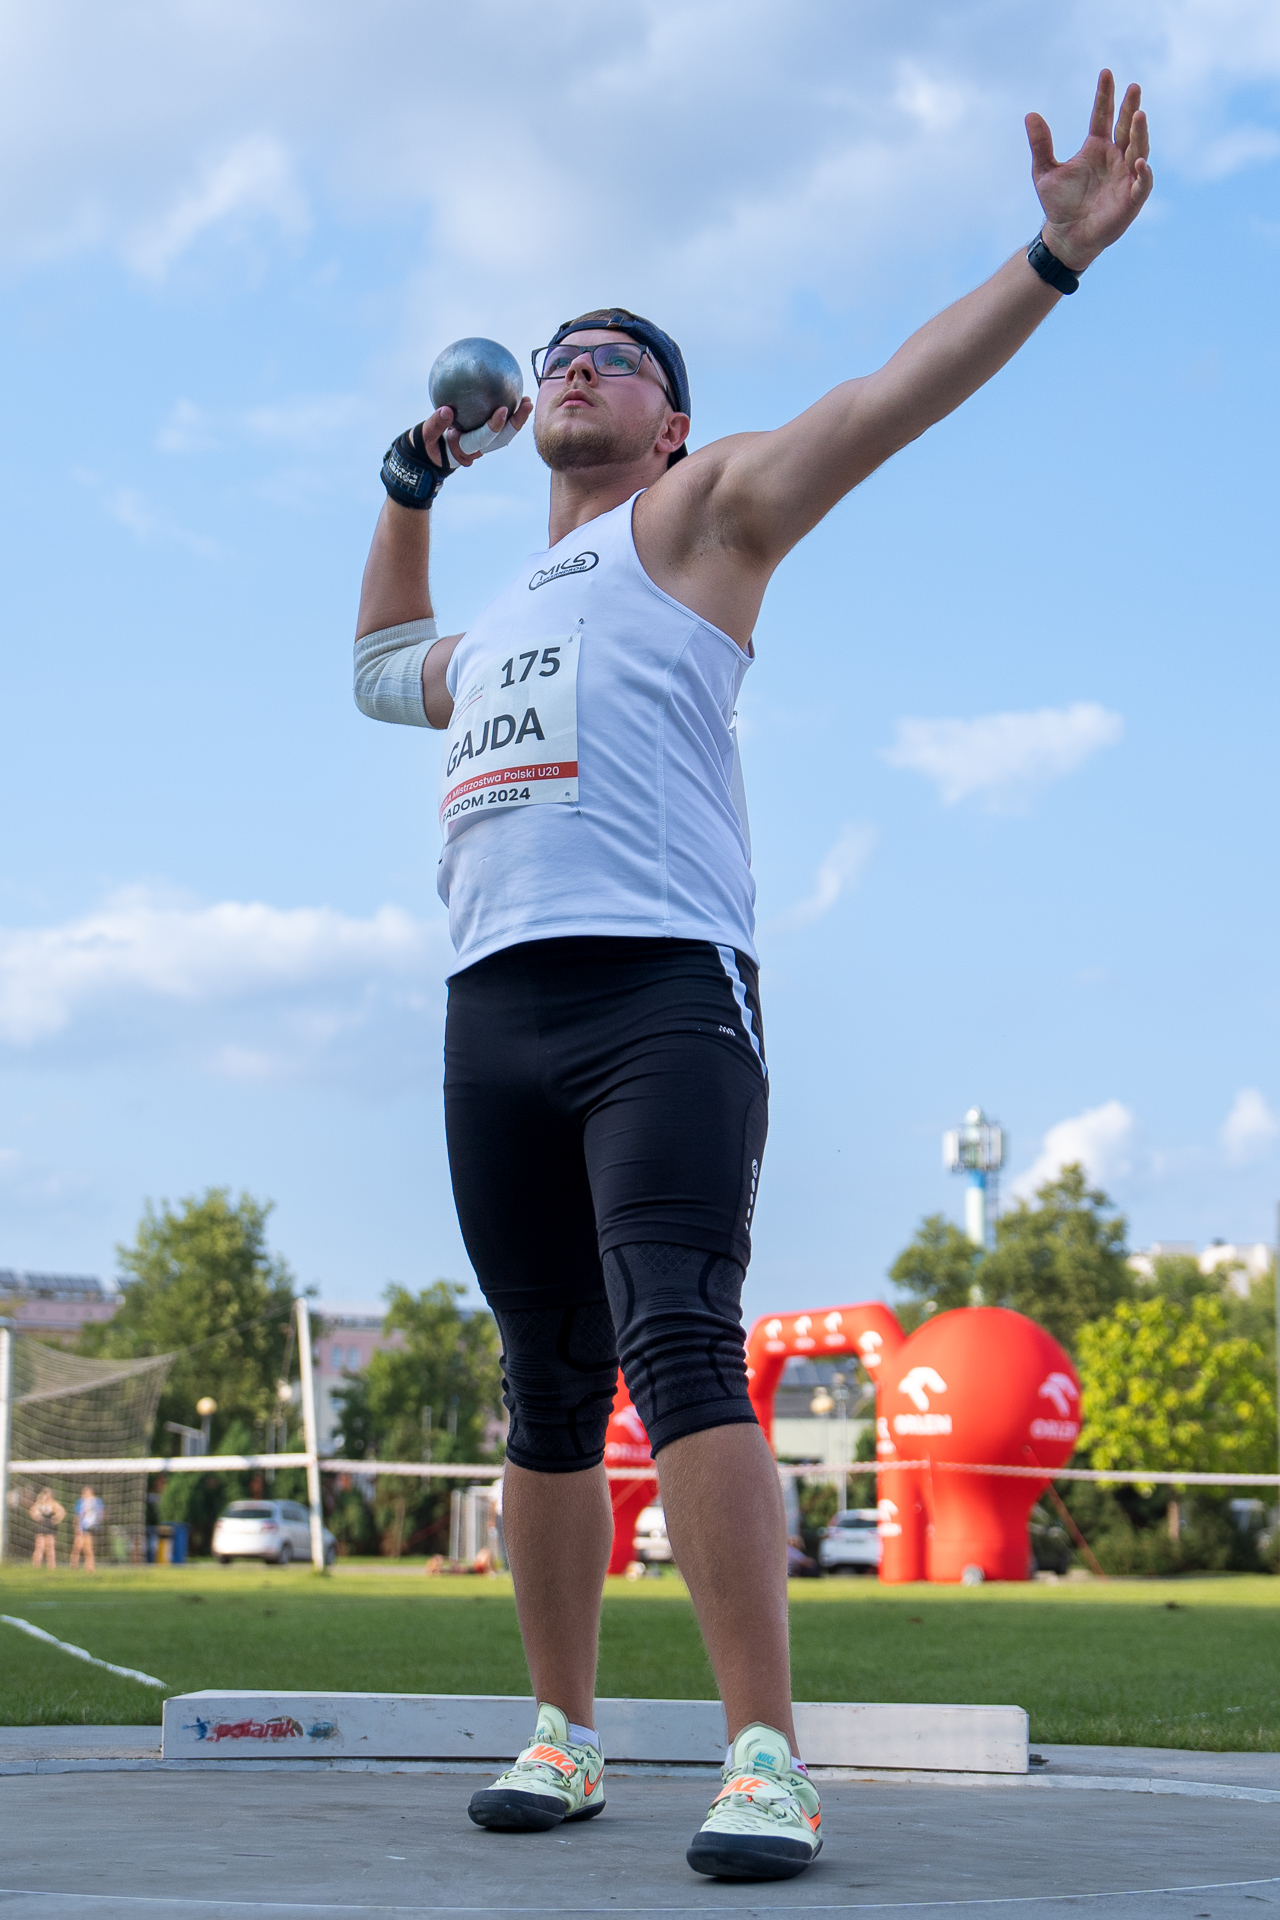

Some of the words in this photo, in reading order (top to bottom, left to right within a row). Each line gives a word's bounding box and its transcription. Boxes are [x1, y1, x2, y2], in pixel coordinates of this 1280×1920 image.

[501, 646, 561, 689] 175
[447, 707, 546, 778] GAJDA
[452, 774, 502, 798] Mistrzostwa
[504, 768, 536, 781] Polski
[538, 766, 560, 777] U20
[488, 787, 531, 804] 2024
[524, 1745, 577, 1777] NIKE
[755, 1752, 777, 1766] NIKE
